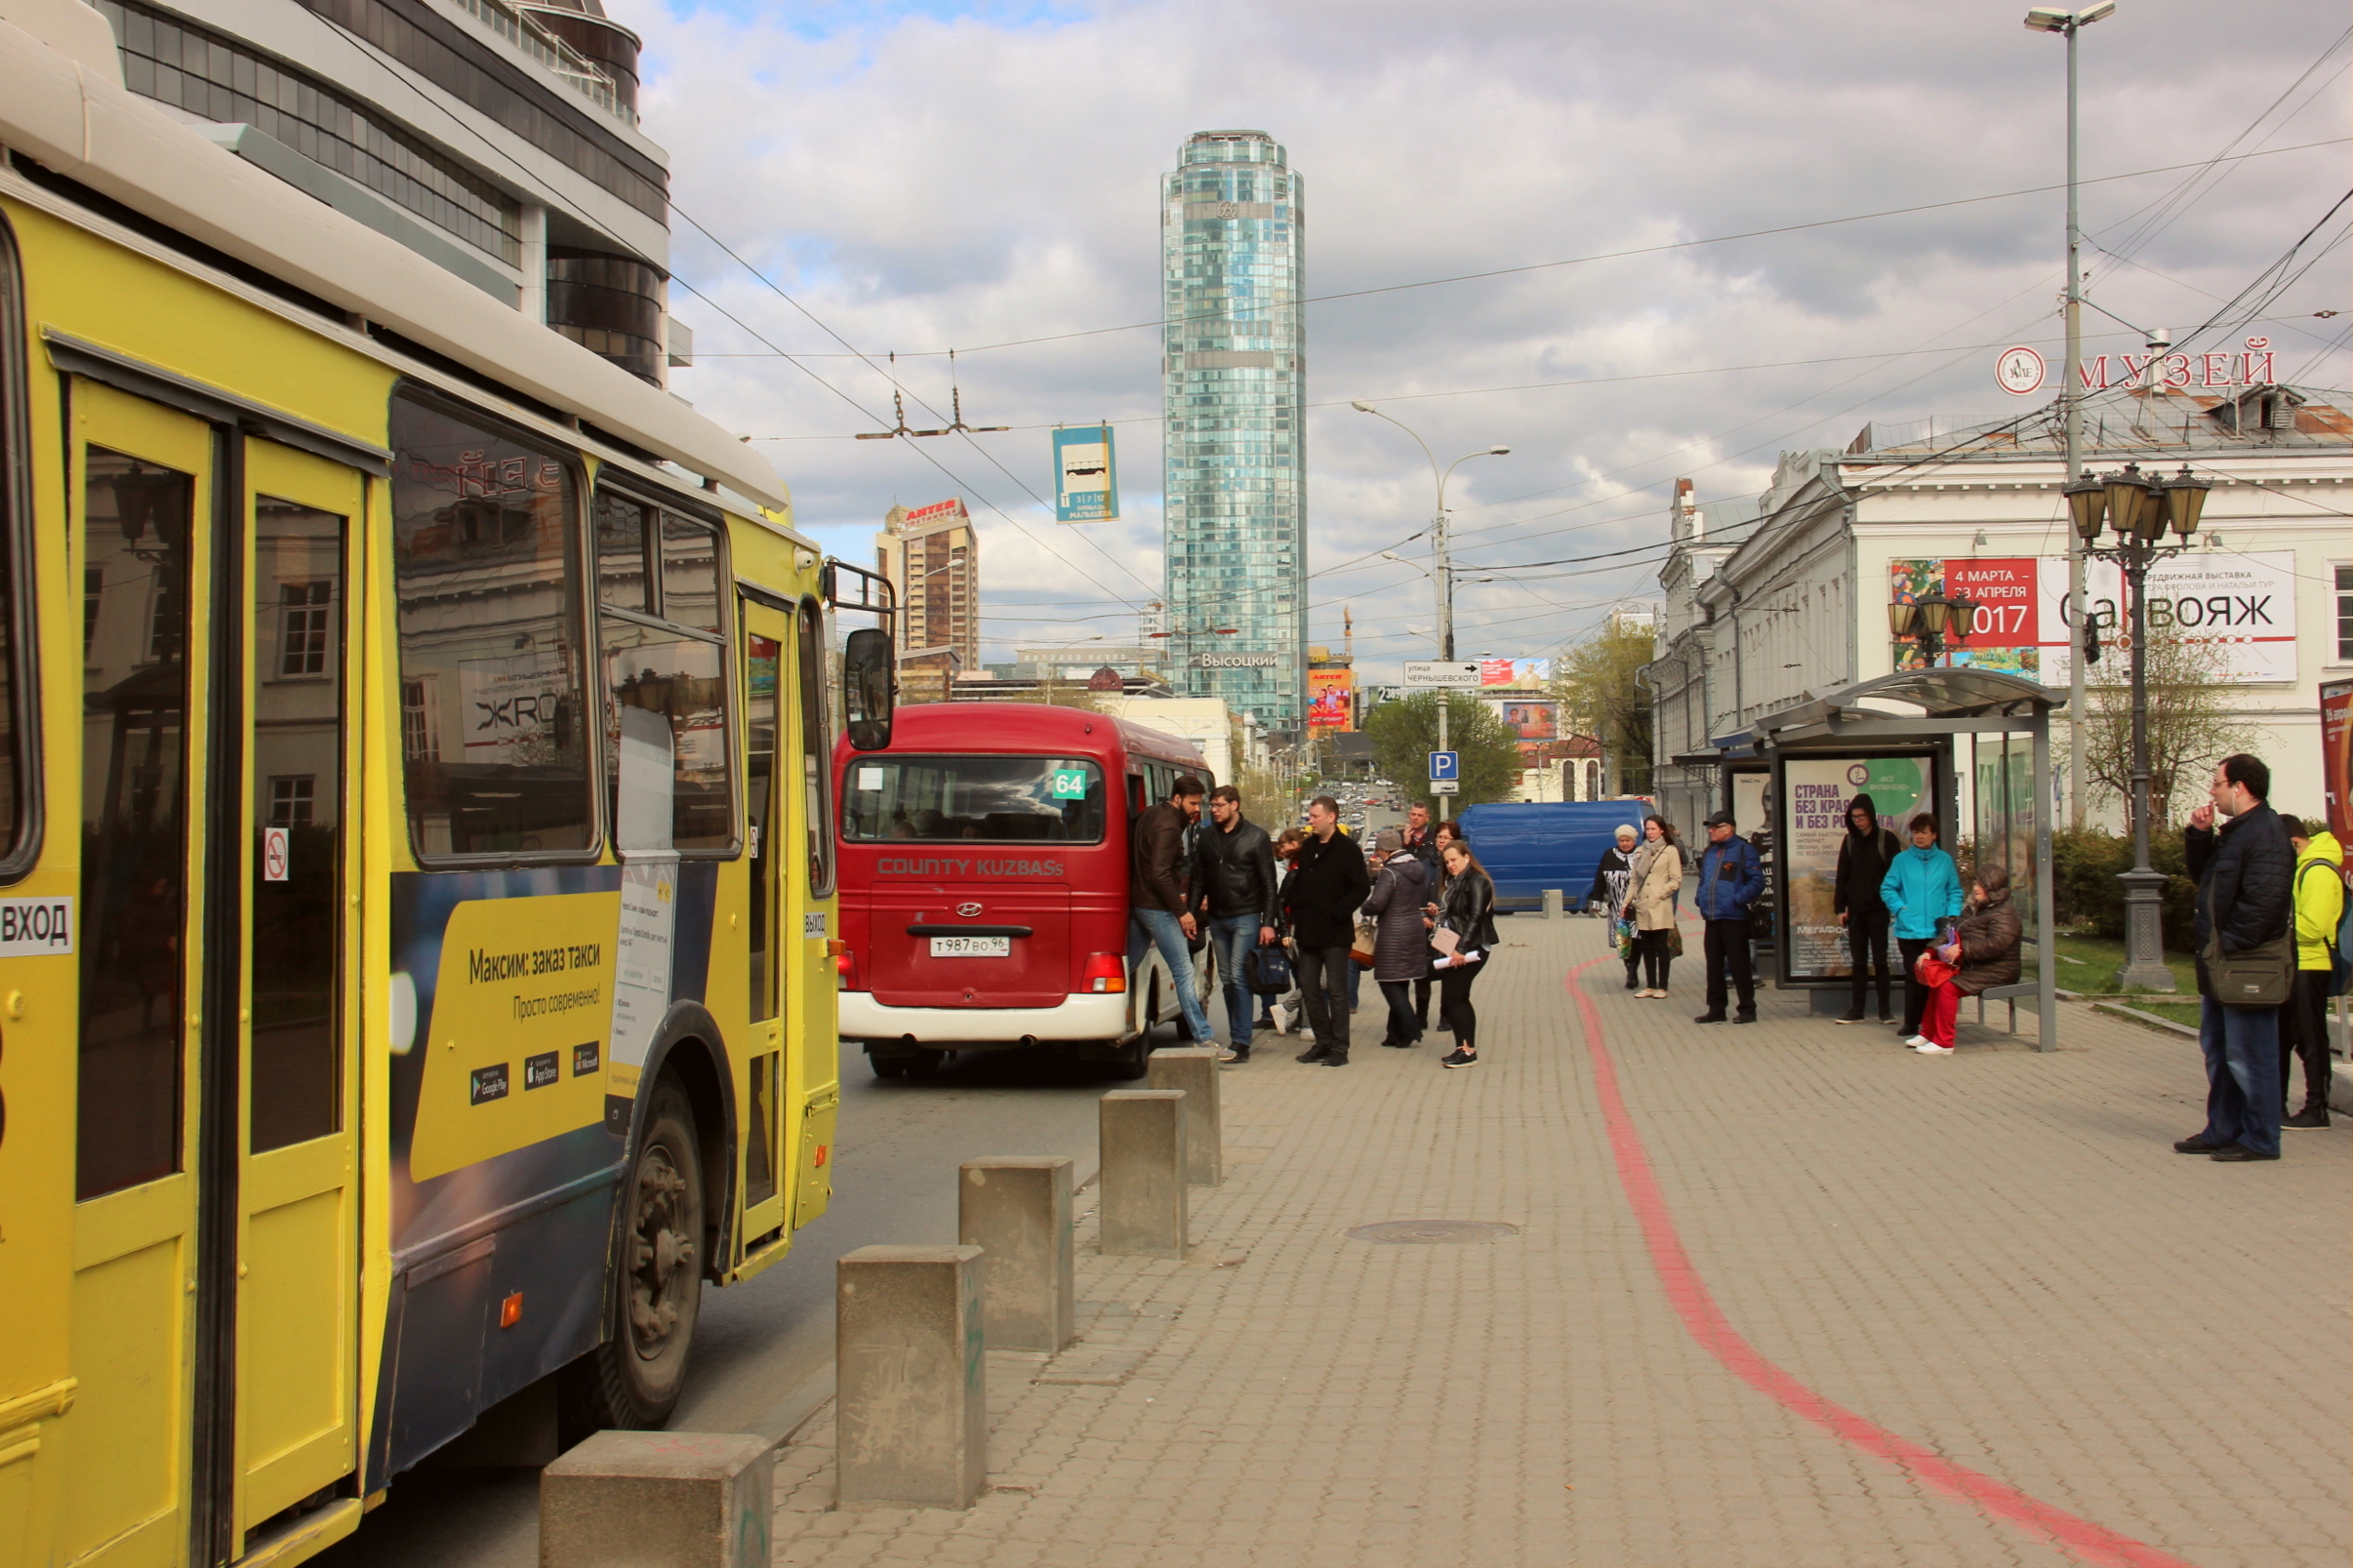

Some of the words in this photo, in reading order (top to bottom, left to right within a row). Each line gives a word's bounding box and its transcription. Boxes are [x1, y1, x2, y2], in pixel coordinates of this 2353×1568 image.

[2080, 337, 2276, 389] МУЗЕЙ
[1069, 510, 1113, 519] МАЛЫШЕВА
[1955, 571, 1965, 582] 4
[1968, 570, 2014, 582] МАРТА
[2206, 571, 2252, 580] ВЫСТАВКА
[1975, 585, 2027, 598] АПРЕЛЯ
[1969, 605, 2027, 634] 017
[1201, 653, 1278, 667] Высоцкий
[1056, 774, 1083, 793] 64
[1795, 784, 1839, 798] СТРАНА
[1796, 800, 1816, 813] БЕЗ
[1821, 799, 1850, 813] КРАЯ
[1796, 816, 1803, 828] И
[1807, 816, 1828, 828] БЕЗ
[878, 859, 970, 874] COUNTY
[2, 905, 68, 946] ВХОД
[805, 913, 826, 935] ВЫХОД
[992, 938, 1004, 947] 96
[469, 948, 529, 985] Максим:
[532, 947, 565, 975] заказ
[568, 944, 600, 970] такси
[513, 995, 548, 1025] Просто
[548, 982, 601, 1016] современно!
[582, 1055, 598, 1069] Microsoft
[535, 1069, 546, 1085] App
[545, 1066, 556, 1080] Store
[482, 1078, 498, 1097] Google
[497, 1078, 507, 1093] Play
